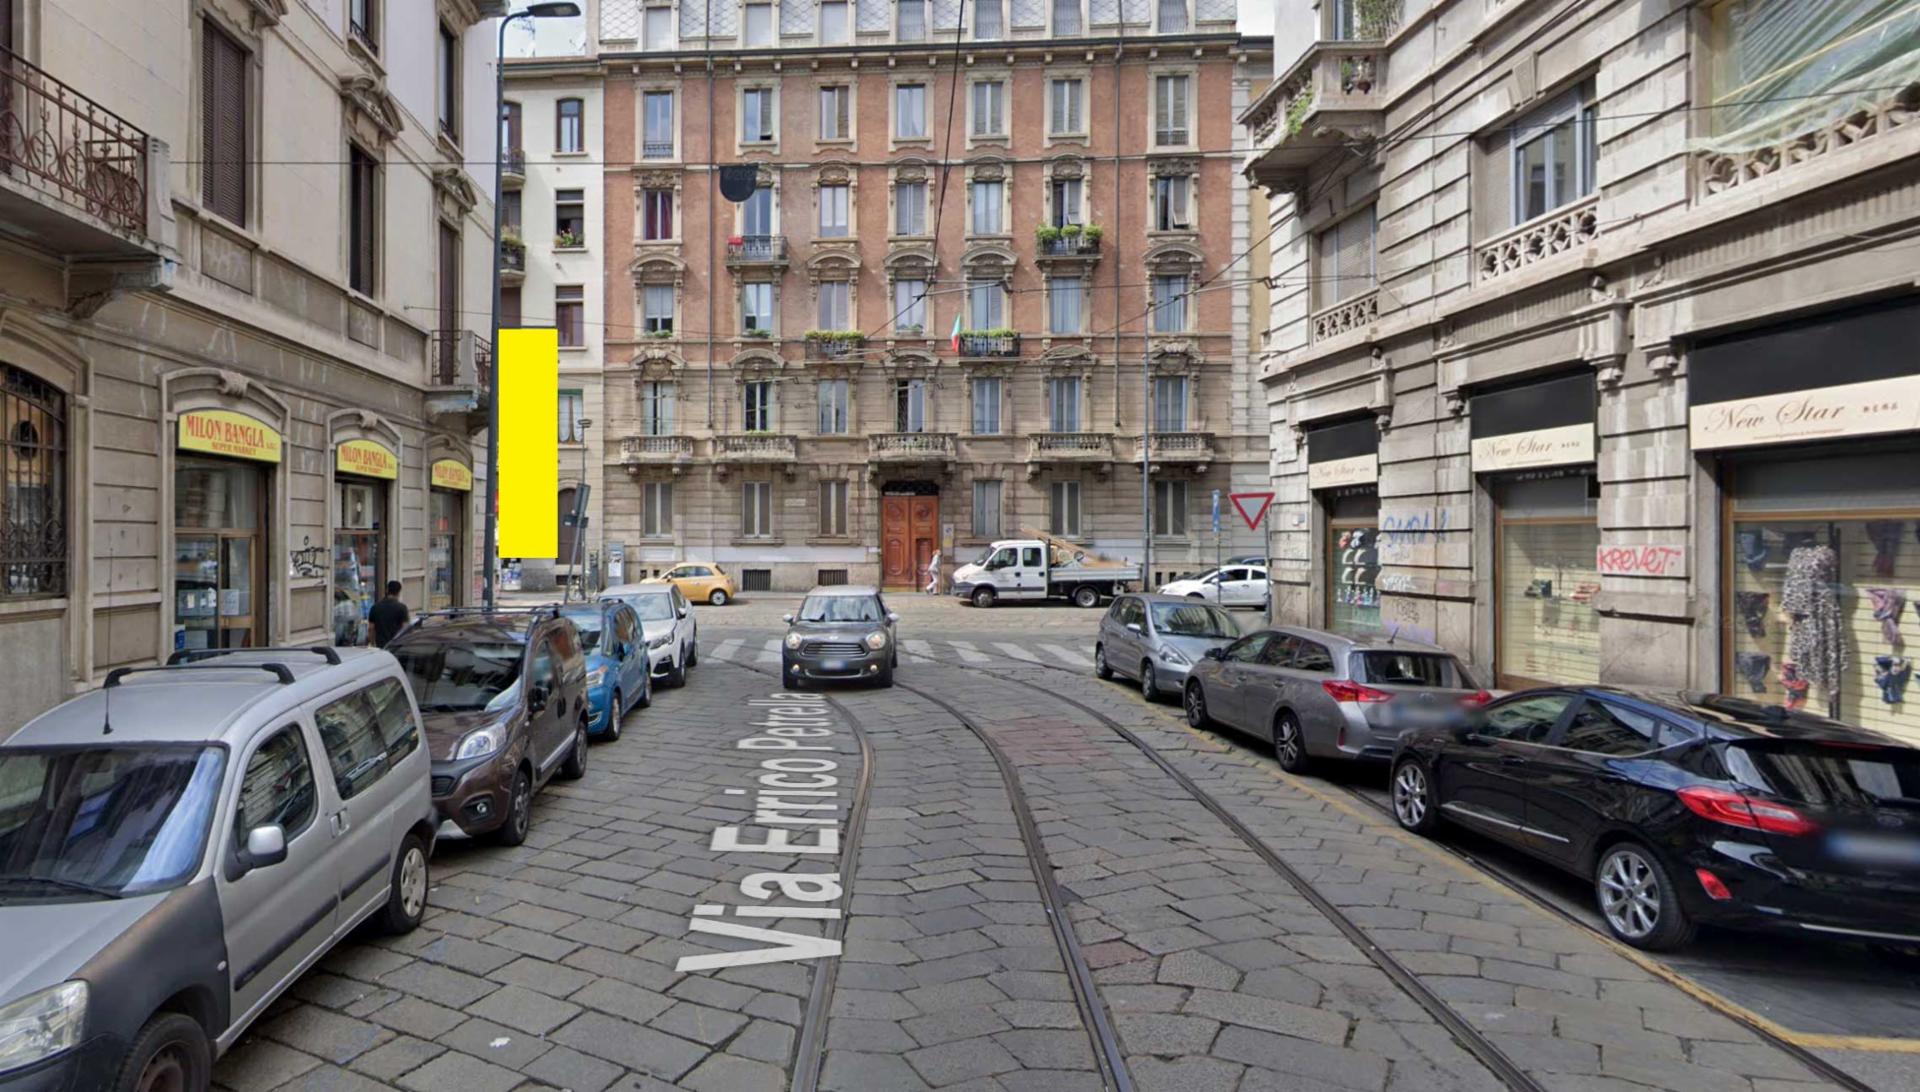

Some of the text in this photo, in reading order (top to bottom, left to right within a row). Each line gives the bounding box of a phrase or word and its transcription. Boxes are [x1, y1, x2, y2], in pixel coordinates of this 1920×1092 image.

[1704, 399, 1845, 432] New Star
[185, 414, 264, 448] MILON BANGLA
[341, 444, 388, 468] MILON BANGLA
[1479, 435, 1553, 459] New Star
